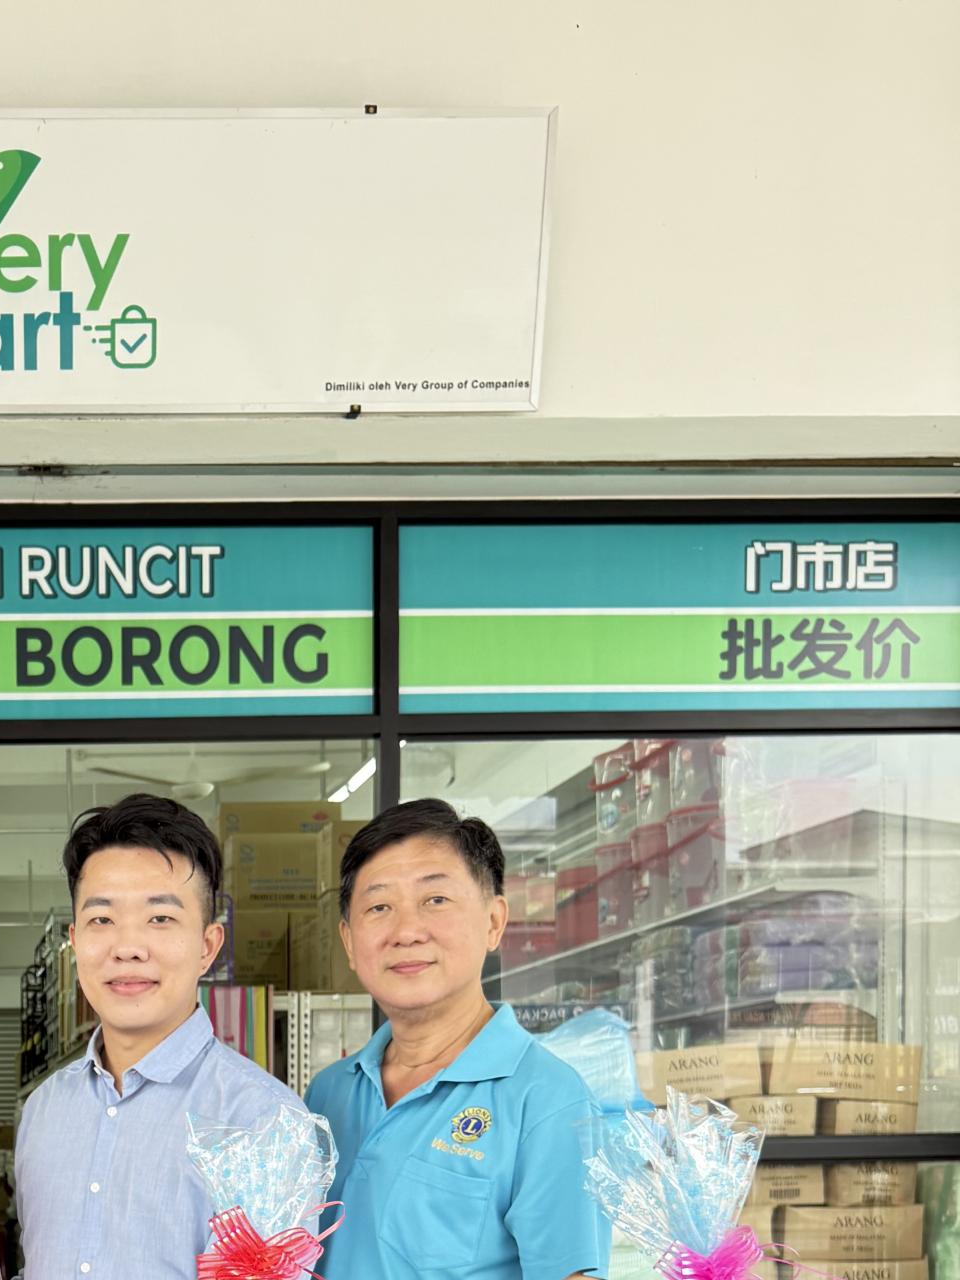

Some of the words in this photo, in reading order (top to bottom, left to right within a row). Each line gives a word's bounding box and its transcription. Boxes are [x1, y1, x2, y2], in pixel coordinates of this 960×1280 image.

[325, 381, 365, 392] Dimiliki
[368, 381, 391, 391] oleh
[394, 381, 418, 392] Very
[421, 380, 454, 392] Group
[457, 379, 468, 390] of
[471, 379, 530, 391] Companies
[20, 545, 225, 599] RUNCIT
[744, 539, 899, 593] 门市店
[15, 623, 330, 687] BORONG
[720, 618, 921, 681] 批发价
[668, 1055, 720, 1072] ARANG
[822, 1051, 874, 1066] ARANG
[748, 1103, 794, 1115] ARANG
[464, 1118, 478, 1134] L
[855, 1113, 898, 1125] ARANG
[833, 1215, 884, 1228] ARANG
[841, 1268, 891, 1280] ARANG
